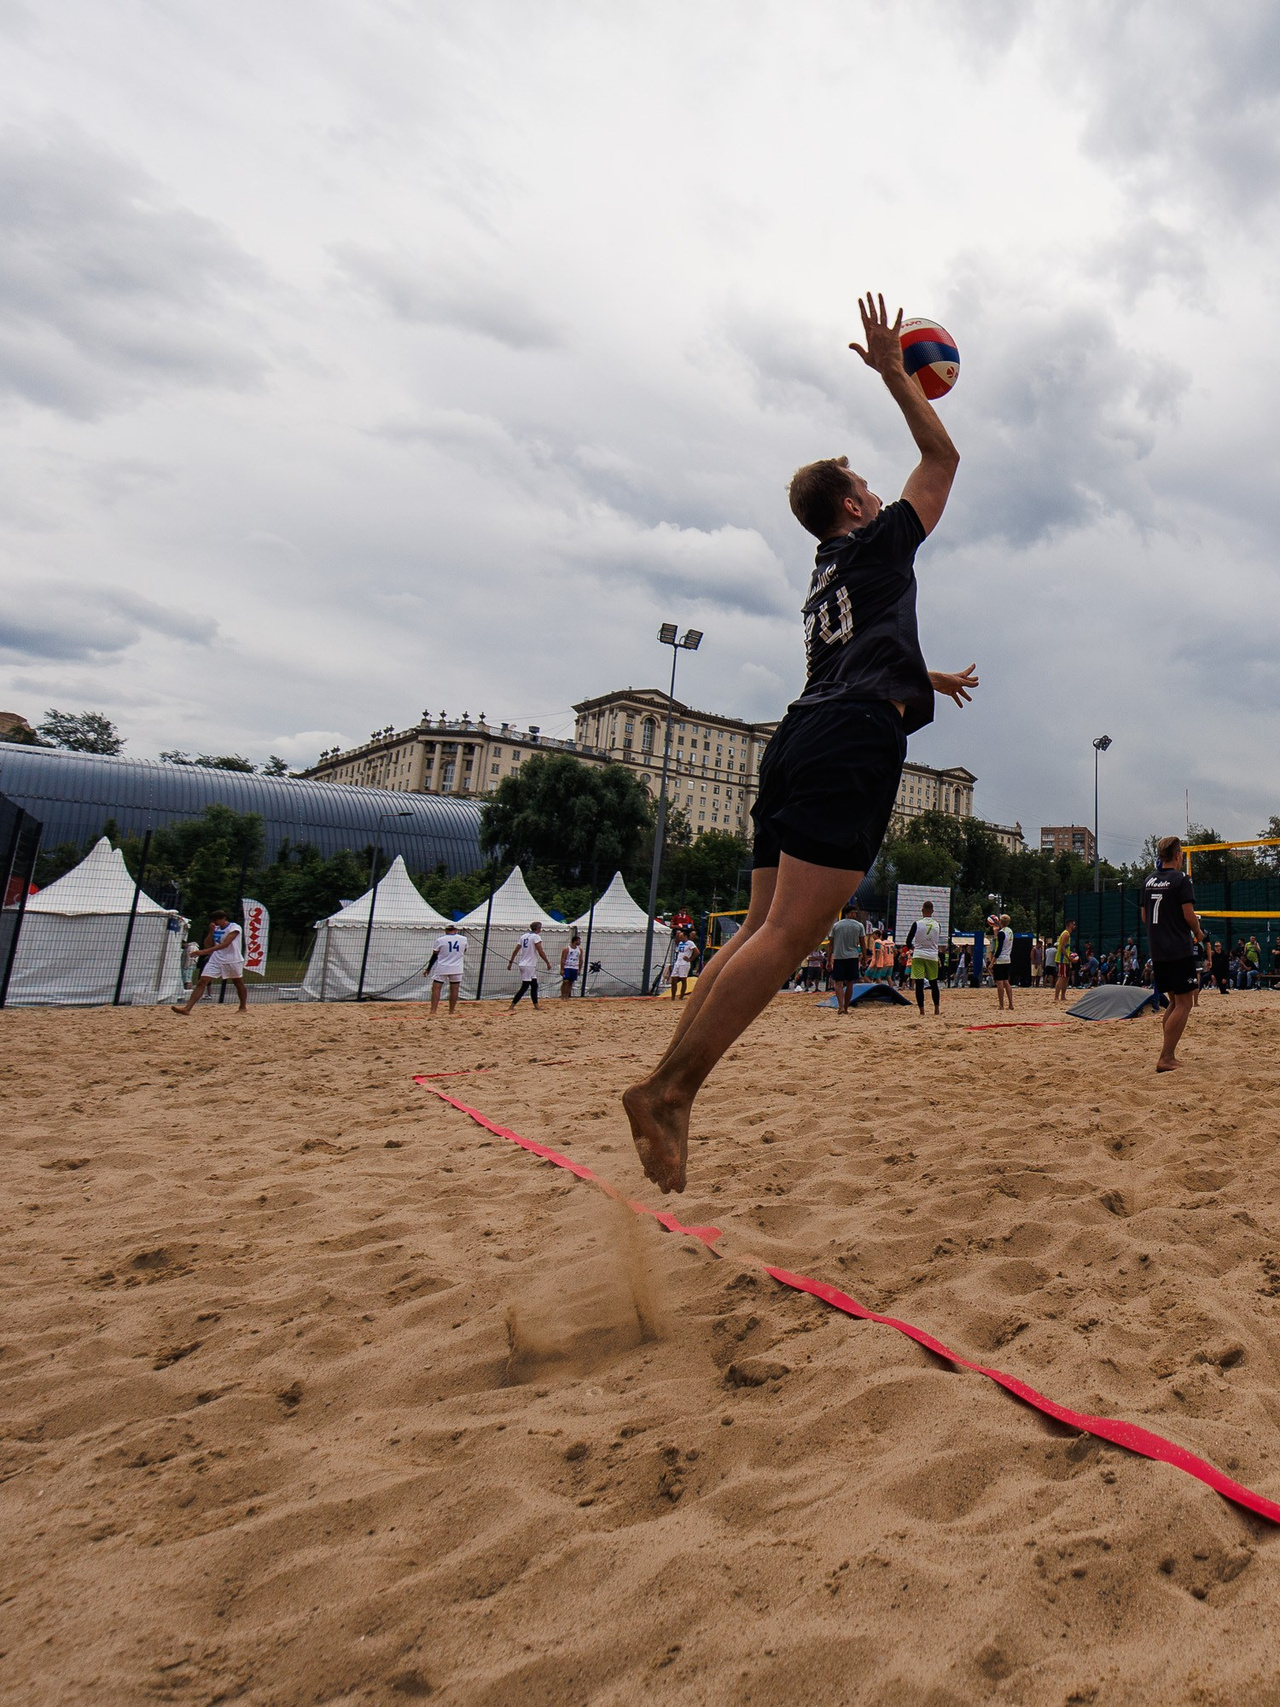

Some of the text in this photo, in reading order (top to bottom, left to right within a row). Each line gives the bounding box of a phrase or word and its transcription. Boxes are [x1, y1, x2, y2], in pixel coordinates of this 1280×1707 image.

[1151, 893, 1163, 924] 7
[925, 923, 933, 936] 7
[447, 940, 460, 953] 14
